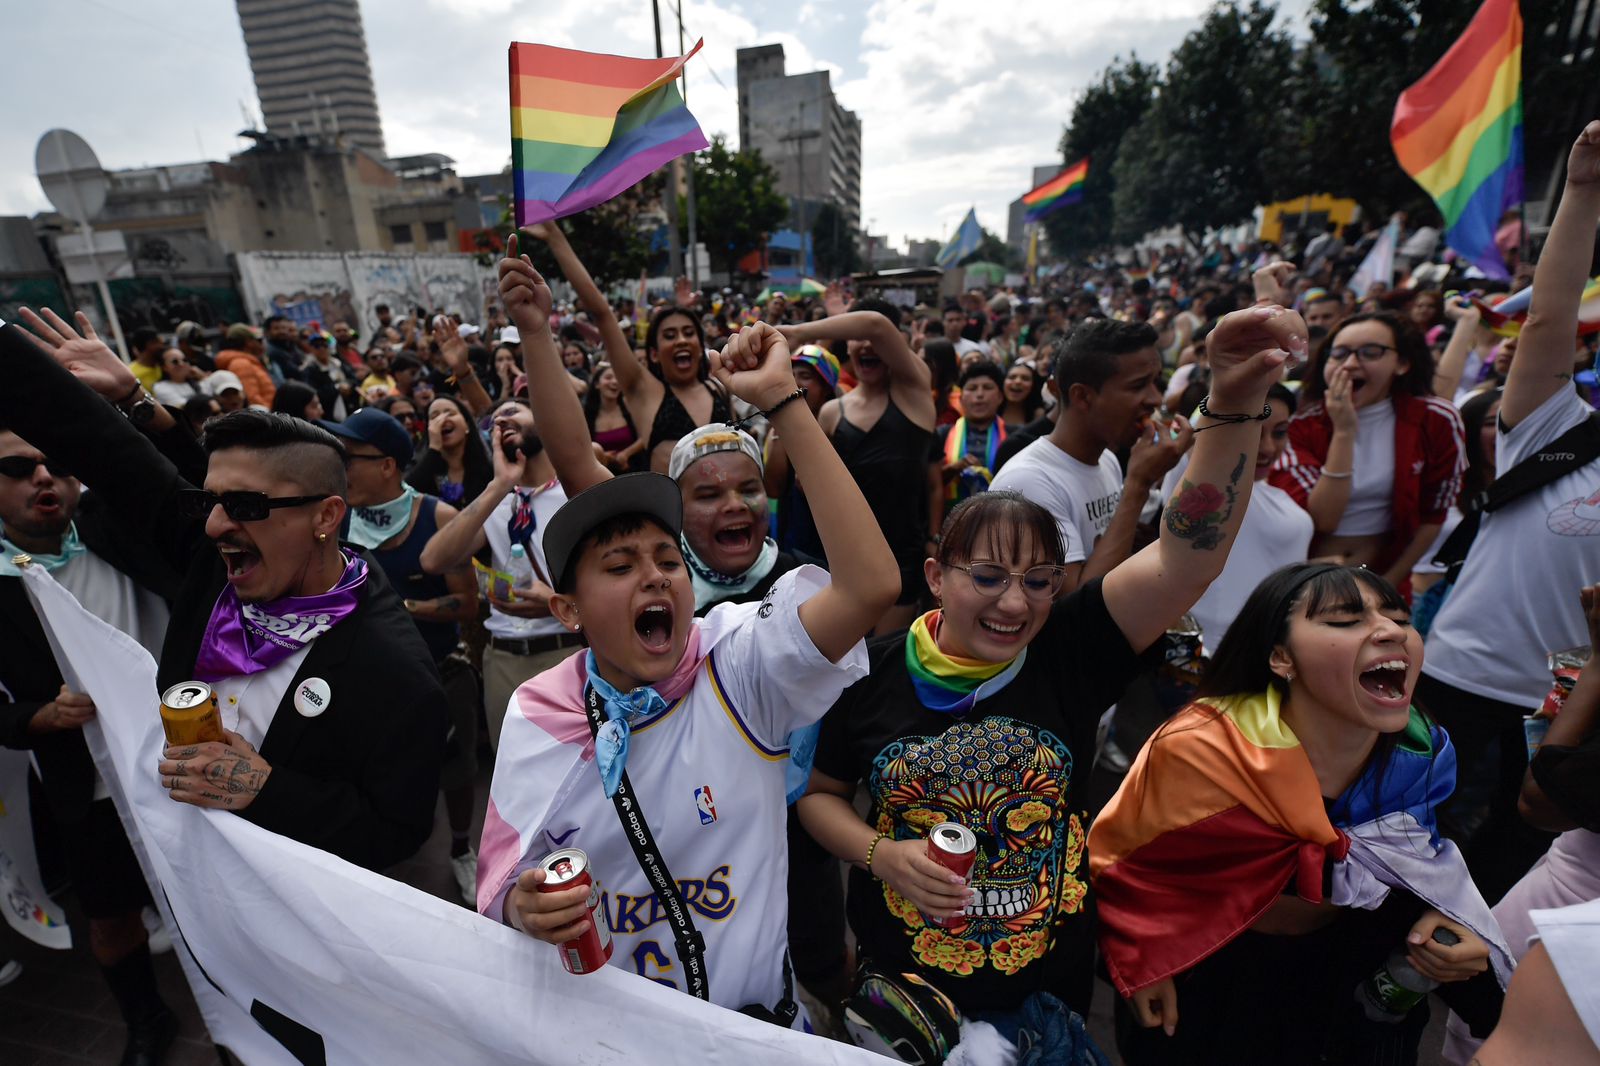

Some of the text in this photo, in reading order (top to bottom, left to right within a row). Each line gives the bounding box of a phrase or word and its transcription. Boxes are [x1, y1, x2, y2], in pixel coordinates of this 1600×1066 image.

[302, 690, 323, 706] CURAR
[628, 811, 648, 847] adidas
[650, 864, 668, 888] adidas
[598, 864, 738, 934] AKERS
[669, 897, 686, 927] adidas
